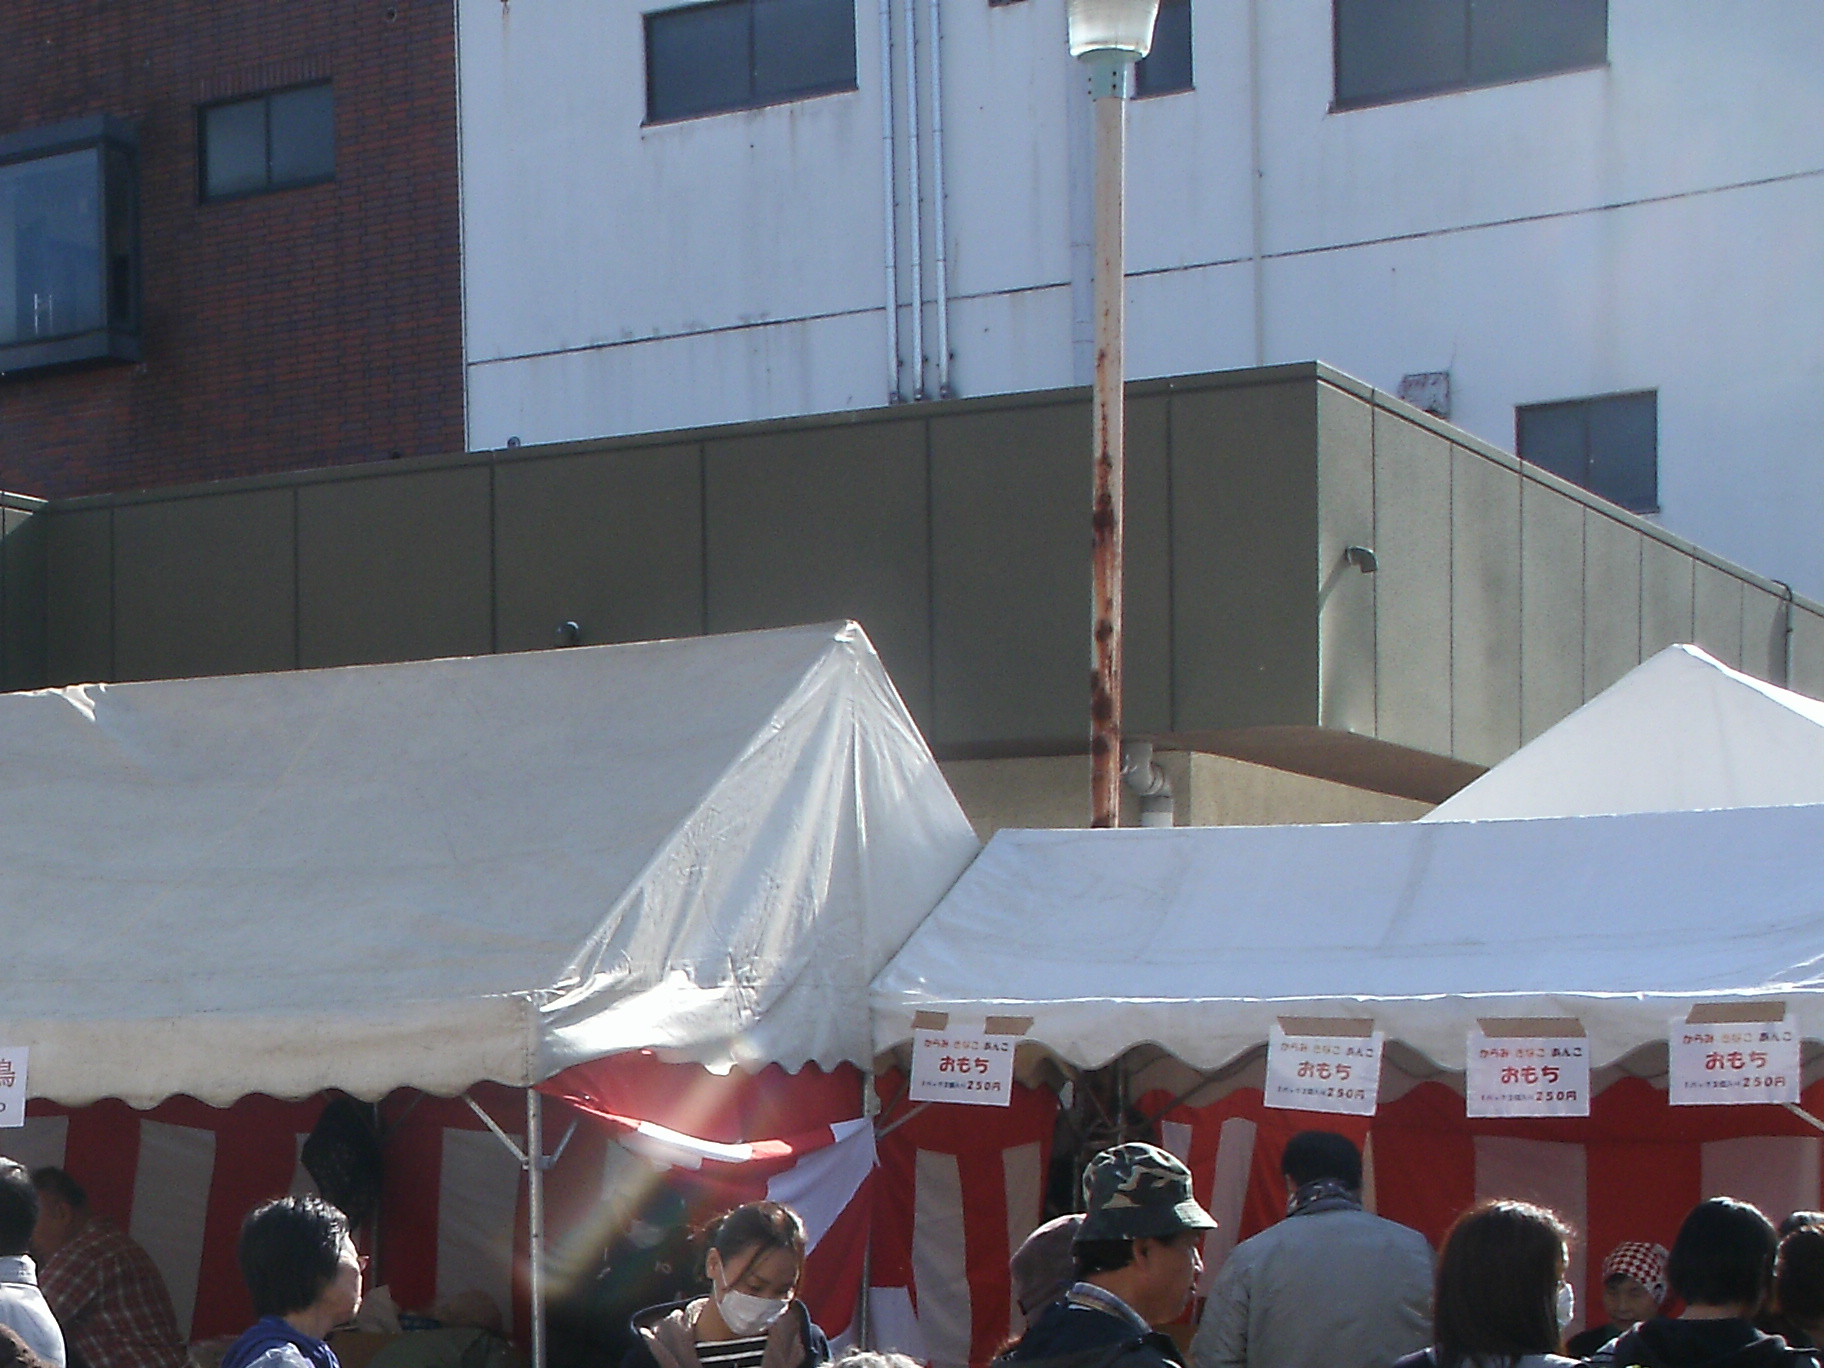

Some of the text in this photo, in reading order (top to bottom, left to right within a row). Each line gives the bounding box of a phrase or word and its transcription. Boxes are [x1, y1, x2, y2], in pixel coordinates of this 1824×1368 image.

[939, 1056, 989, 1074] おもち
[1705, 1051, 1768, 1070] おもち
[1297, 1061, 1351, 1080] おもち
[1501, 1065, 1560, 1084] おもち
